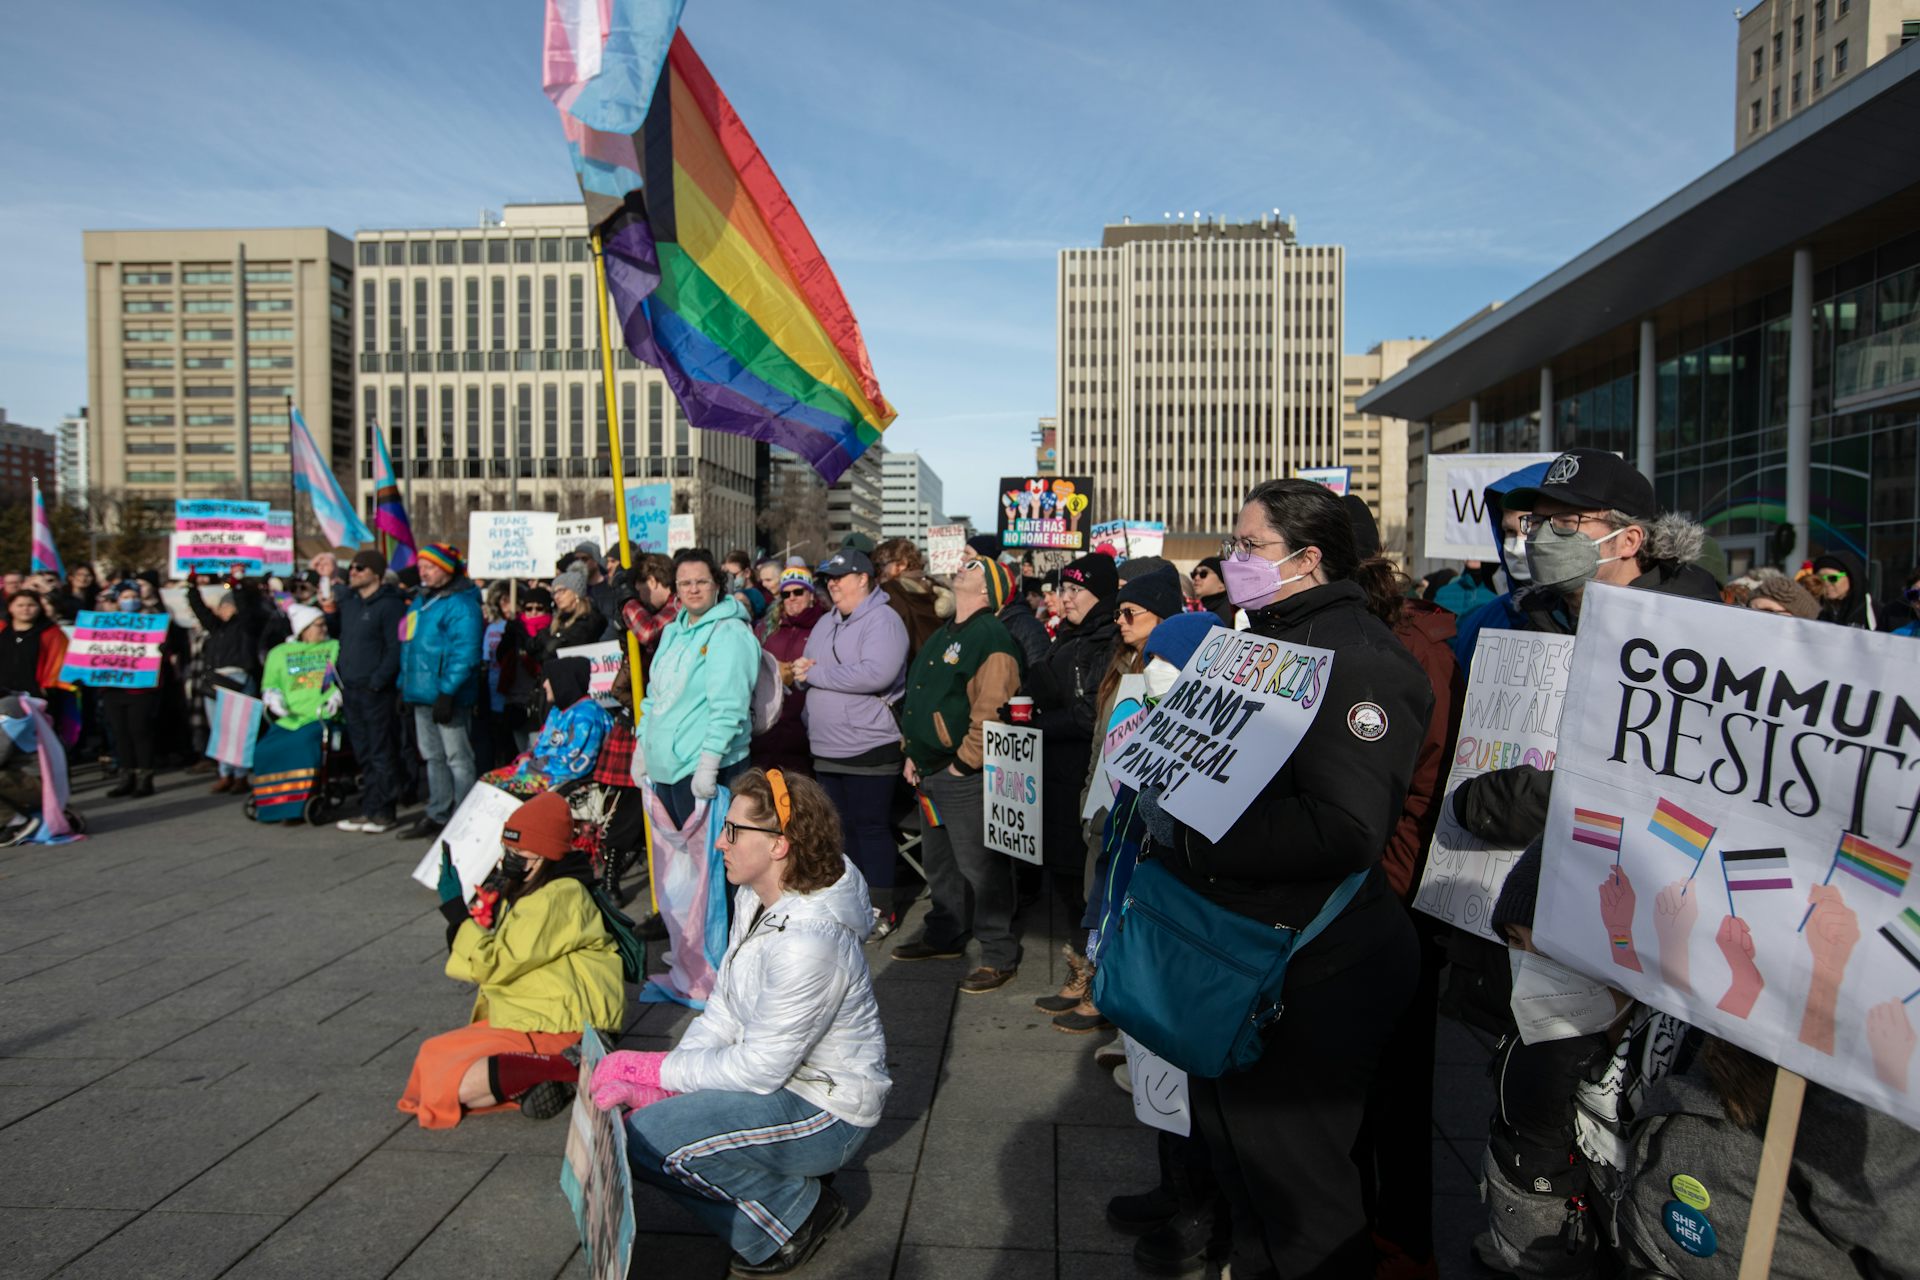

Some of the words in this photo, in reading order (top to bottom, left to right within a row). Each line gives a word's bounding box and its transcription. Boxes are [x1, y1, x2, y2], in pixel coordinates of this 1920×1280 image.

[1004, 532, 1019, 544] NO
[1020, 532, 1050, 544] HOME
[1052, 533, 1080, 546] HERE
[1017, 520, 1041, 532] HATE
[1043, 521, 1065, 532] HAS
[1090, 522, 1121, 539] OPLE
[93, 614, 156, 629] FASCIST
[87, 644, 147, 657] ALWAYS
[90, 657, 139, 669] CAUSE
[90, 670, 136, 683] HARM
[1195, 633, 1280, 692] QUEER
[1264, 650, 1328, 710] KIDS
[1163, 679, 1211, 720] ARE
[1198, 685, 1265, 740] NOT
[1468, 688, 1522, 732] WAY
[986, 730, 1037, 763] PROTECT
[1139, 710, 1238, 784] POLITICAL
[1456, 736, 1521, 772] QUEER
[984, 763, 1037, 805] TRANS
[1113, 742, 1190, 801] PAWNS!
[992, 802, 1025, 832] KIDS
[988, 823, 1036, 857] RIGHTS
[1671, 1210, 1698, 1232] SHE
[1675, 1223, 1702, 1245] HER
